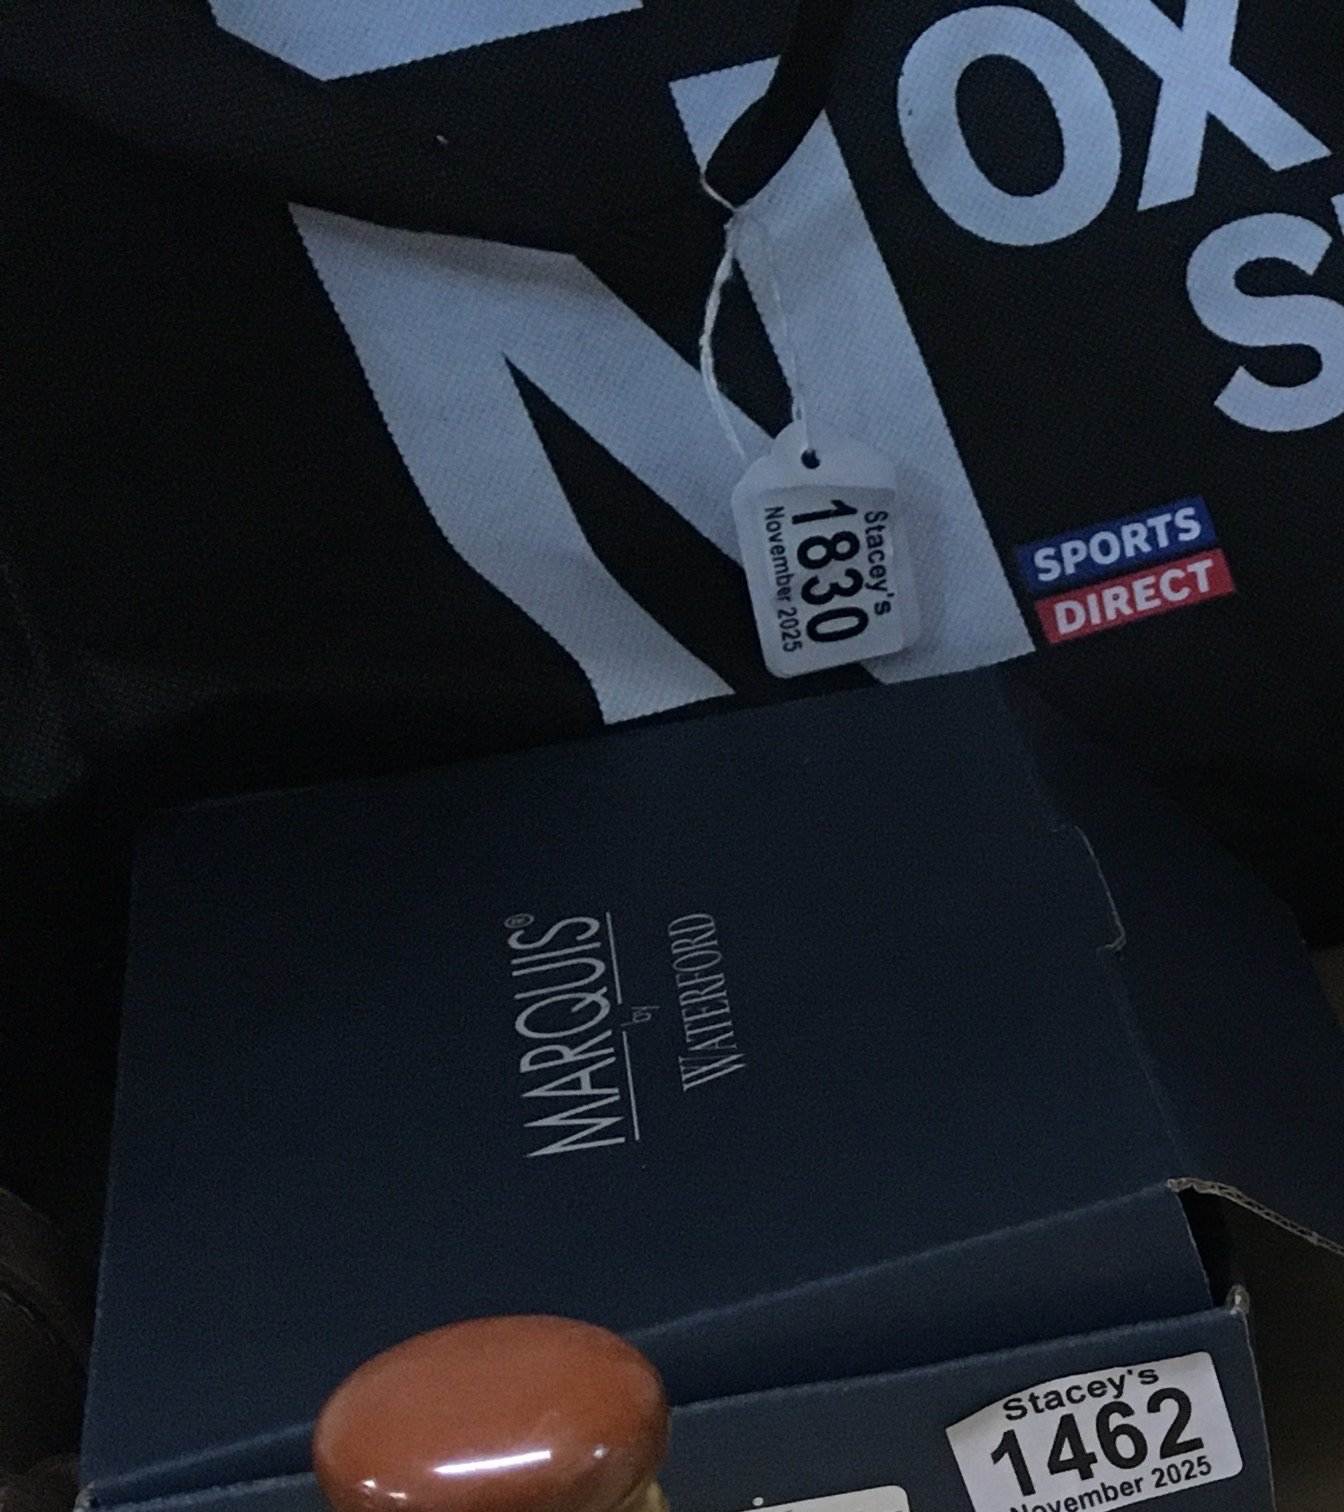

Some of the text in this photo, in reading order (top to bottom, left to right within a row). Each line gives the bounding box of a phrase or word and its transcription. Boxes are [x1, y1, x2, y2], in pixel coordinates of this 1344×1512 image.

[764, 505, 803, 653] November 2025
[791, 499, 869, 643] 1830
[864, 510, 895, 616] Stacey's
[1034, 507, 1201, 582] SPORTS
[1054, 558, 1213, 635] DIRECT
[667, 913, 747, 1092] WATERFORD
[990, 1387, 1204, 1497] 1462
[1002, 1367, 1160, 1422] Stacey's
[1151, 1455, 1212, 1489] 2025
